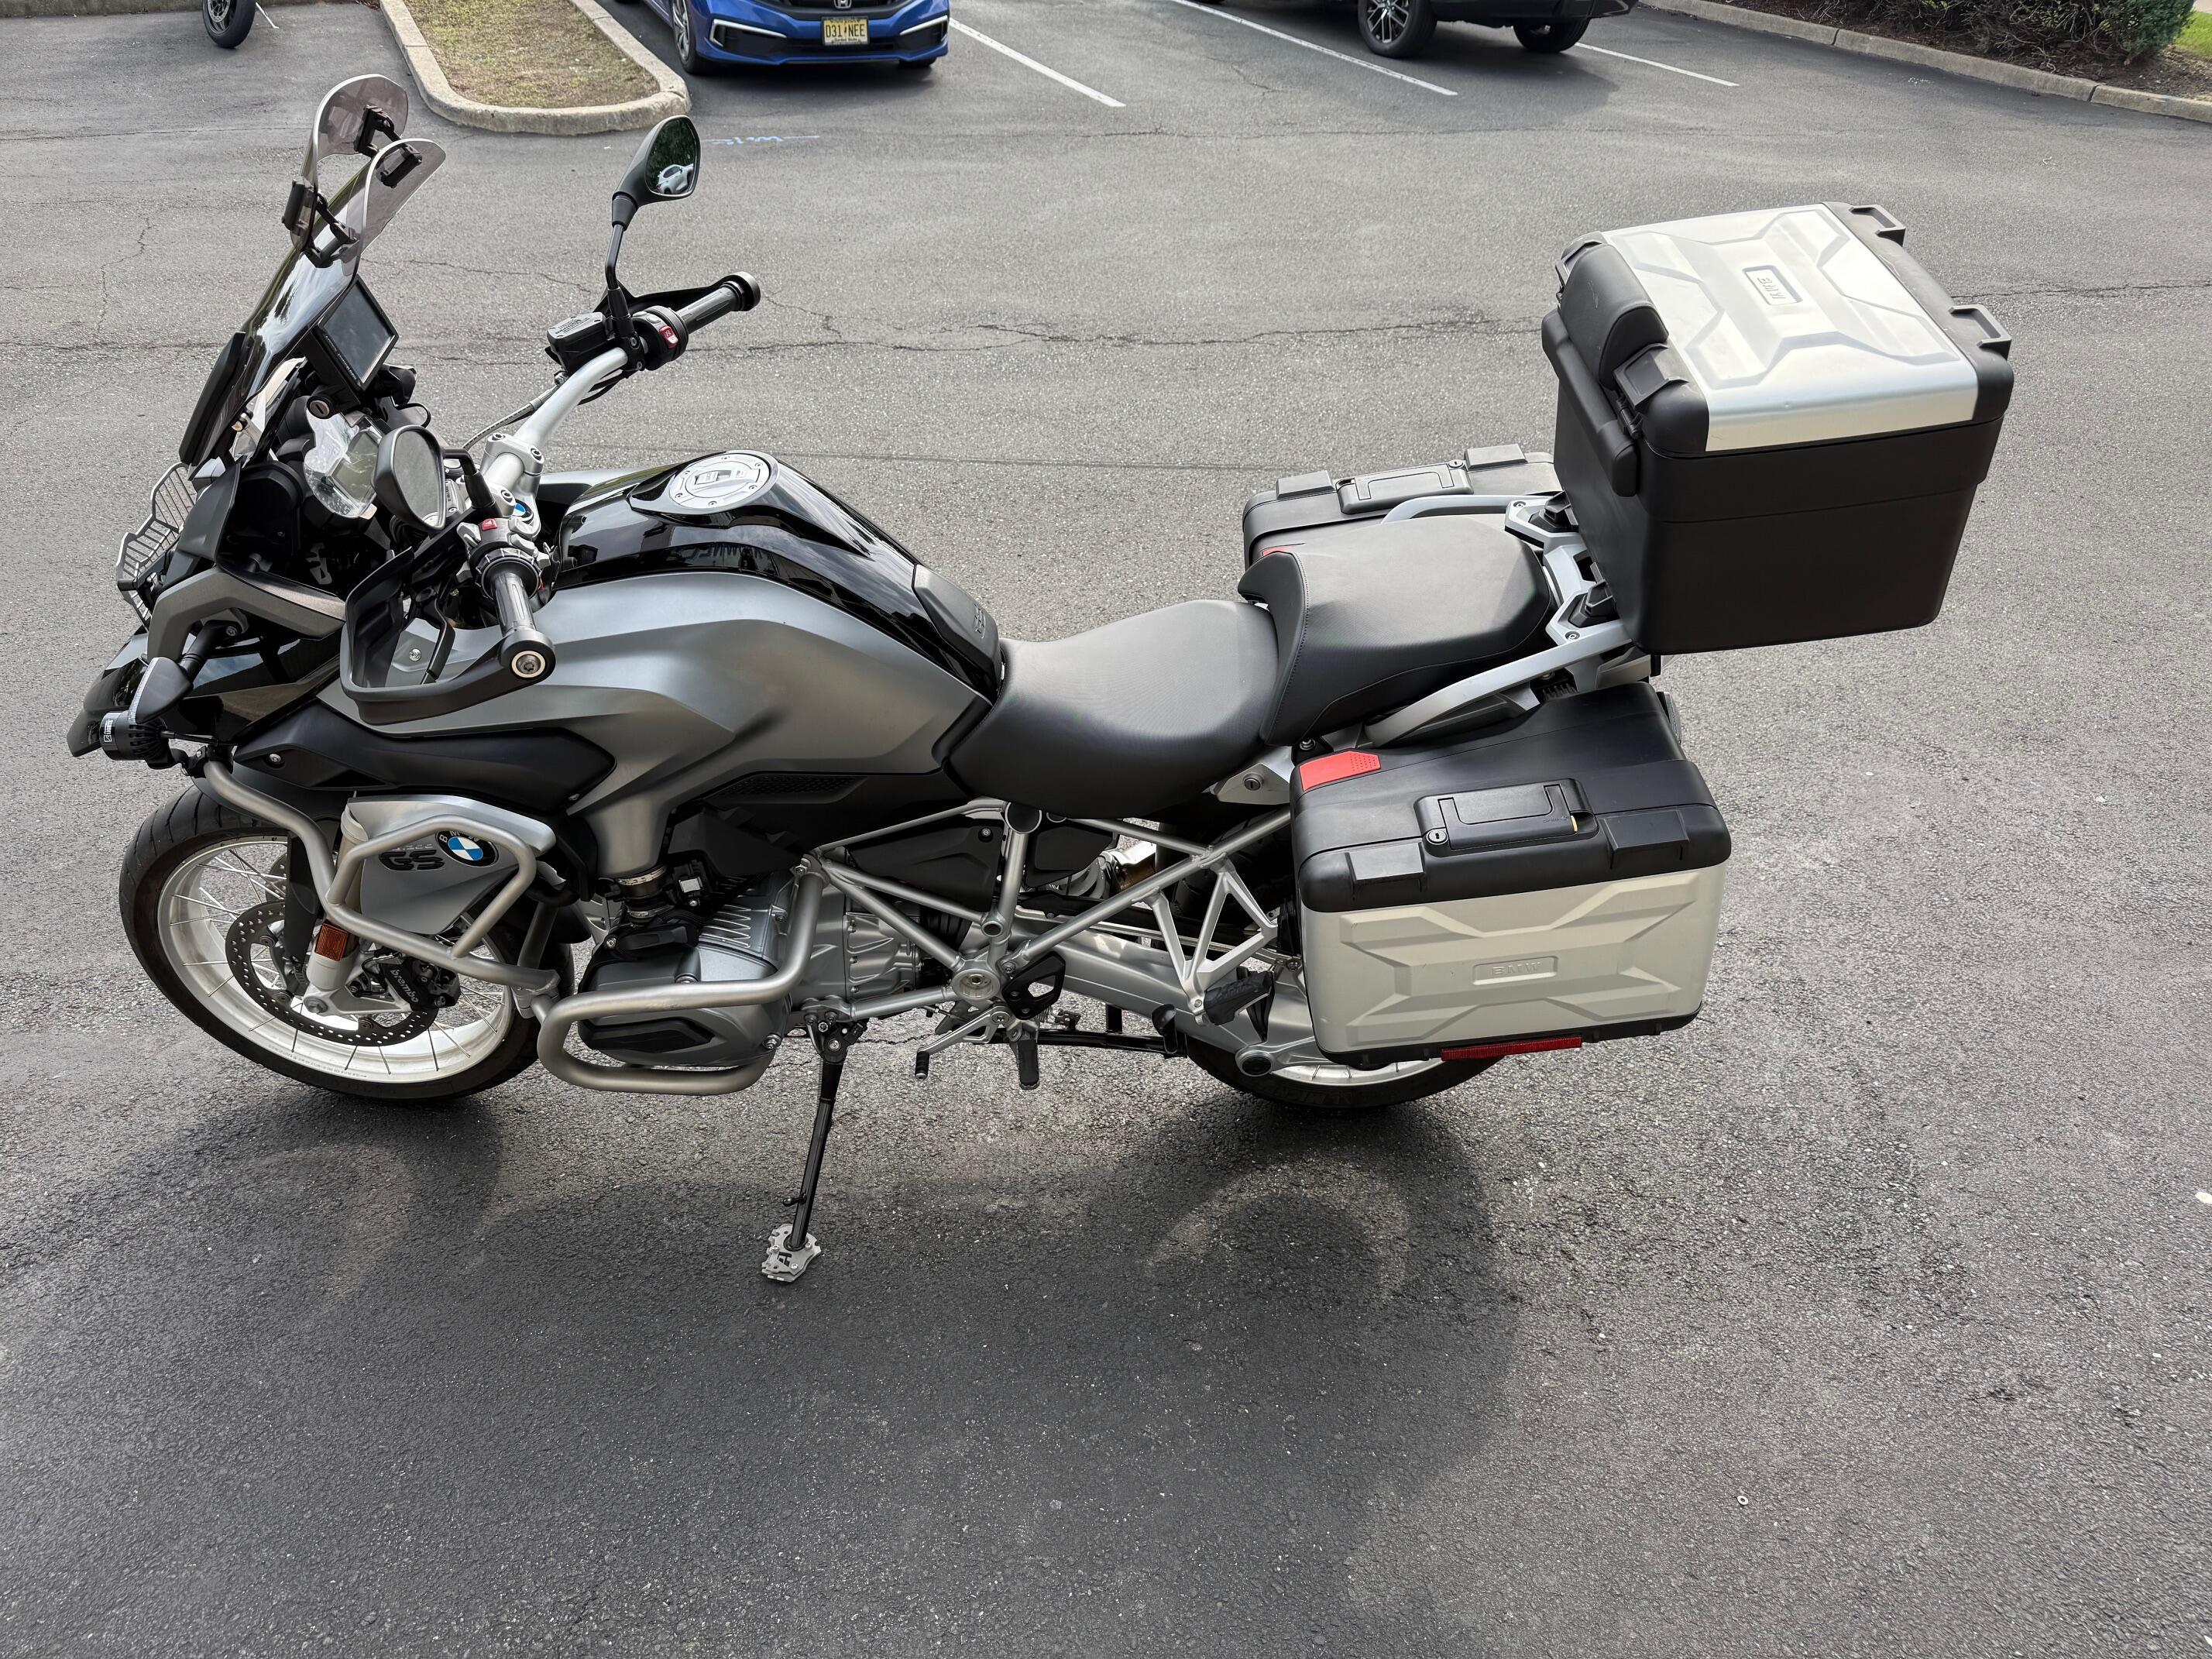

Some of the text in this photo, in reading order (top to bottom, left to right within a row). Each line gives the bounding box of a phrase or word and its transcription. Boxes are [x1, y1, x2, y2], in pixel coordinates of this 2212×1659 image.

[1757, 277, 1786, 299] BMW
[379, 850, 445, 871] GS
[1492, 961, 1541, 976] BMW
[390, 969, 419, 1003] brembo
